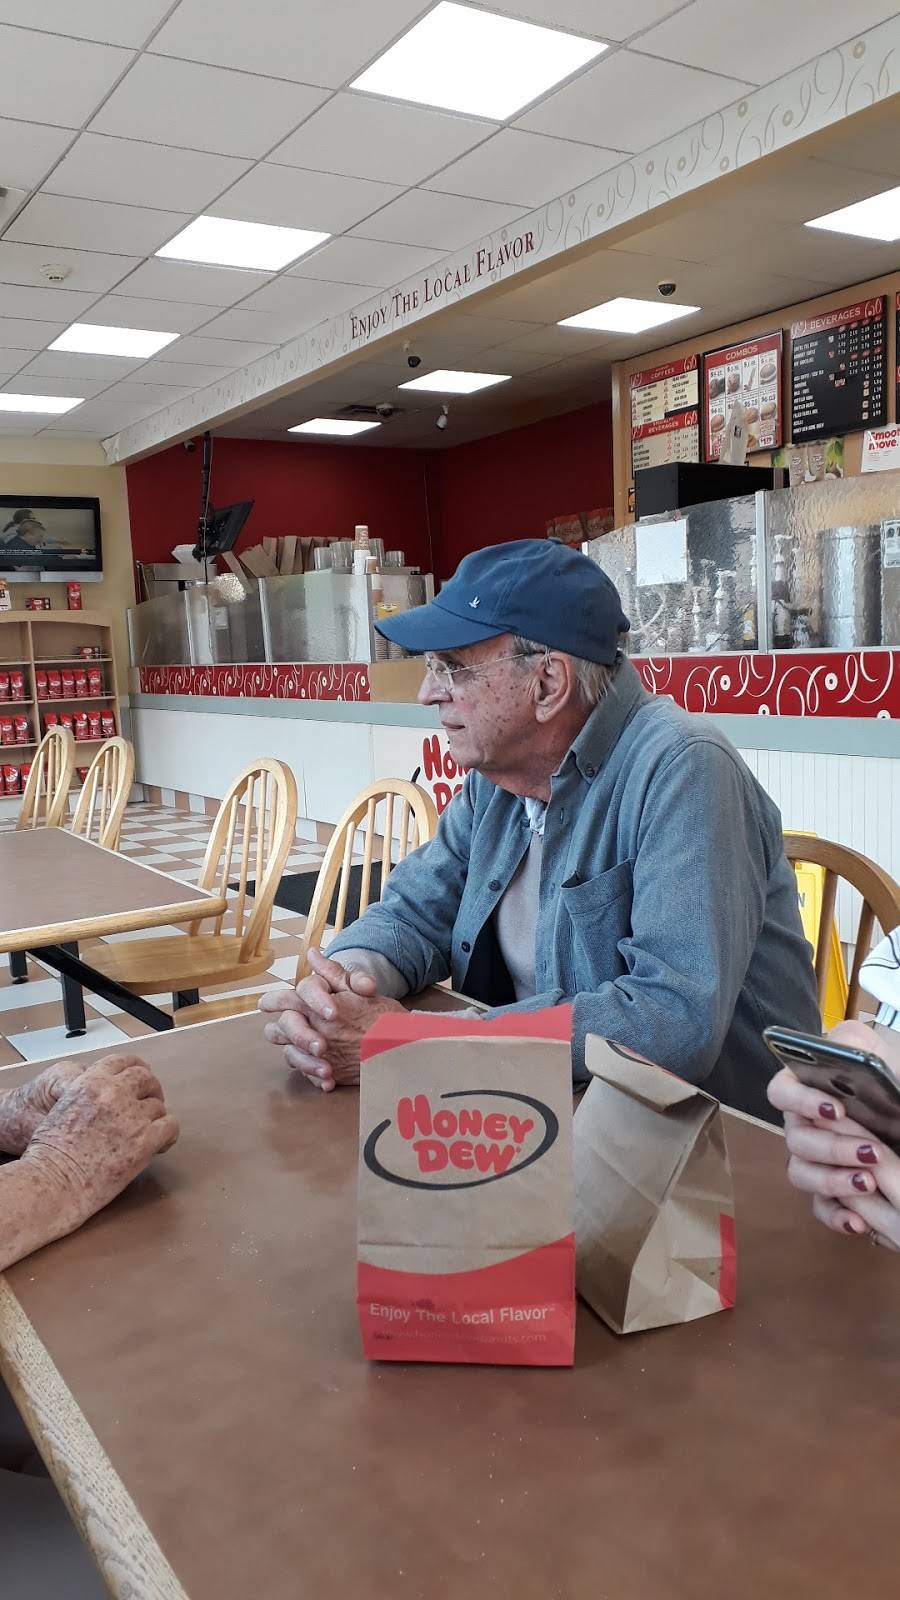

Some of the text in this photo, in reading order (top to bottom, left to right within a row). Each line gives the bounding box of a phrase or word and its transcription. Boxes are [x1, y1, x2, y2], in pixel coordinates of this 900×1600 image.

[350, 231, 536, 339] ENJOY THE LOCAL FLAVOR
[810, 307, 861, 329] BEVERAGES
[725, 344, 759, 361] COMBOS
[648, 421, 679, 434] BEVERAGES
[397, 1094, 534, 1144] HONEY
[412, 1139, 516, 1174] DEW
[369, 1302, 411, 1323] Enjoy
[416, 1308, 446, 1323] The
[452, 1309, 494, 1325] Local
